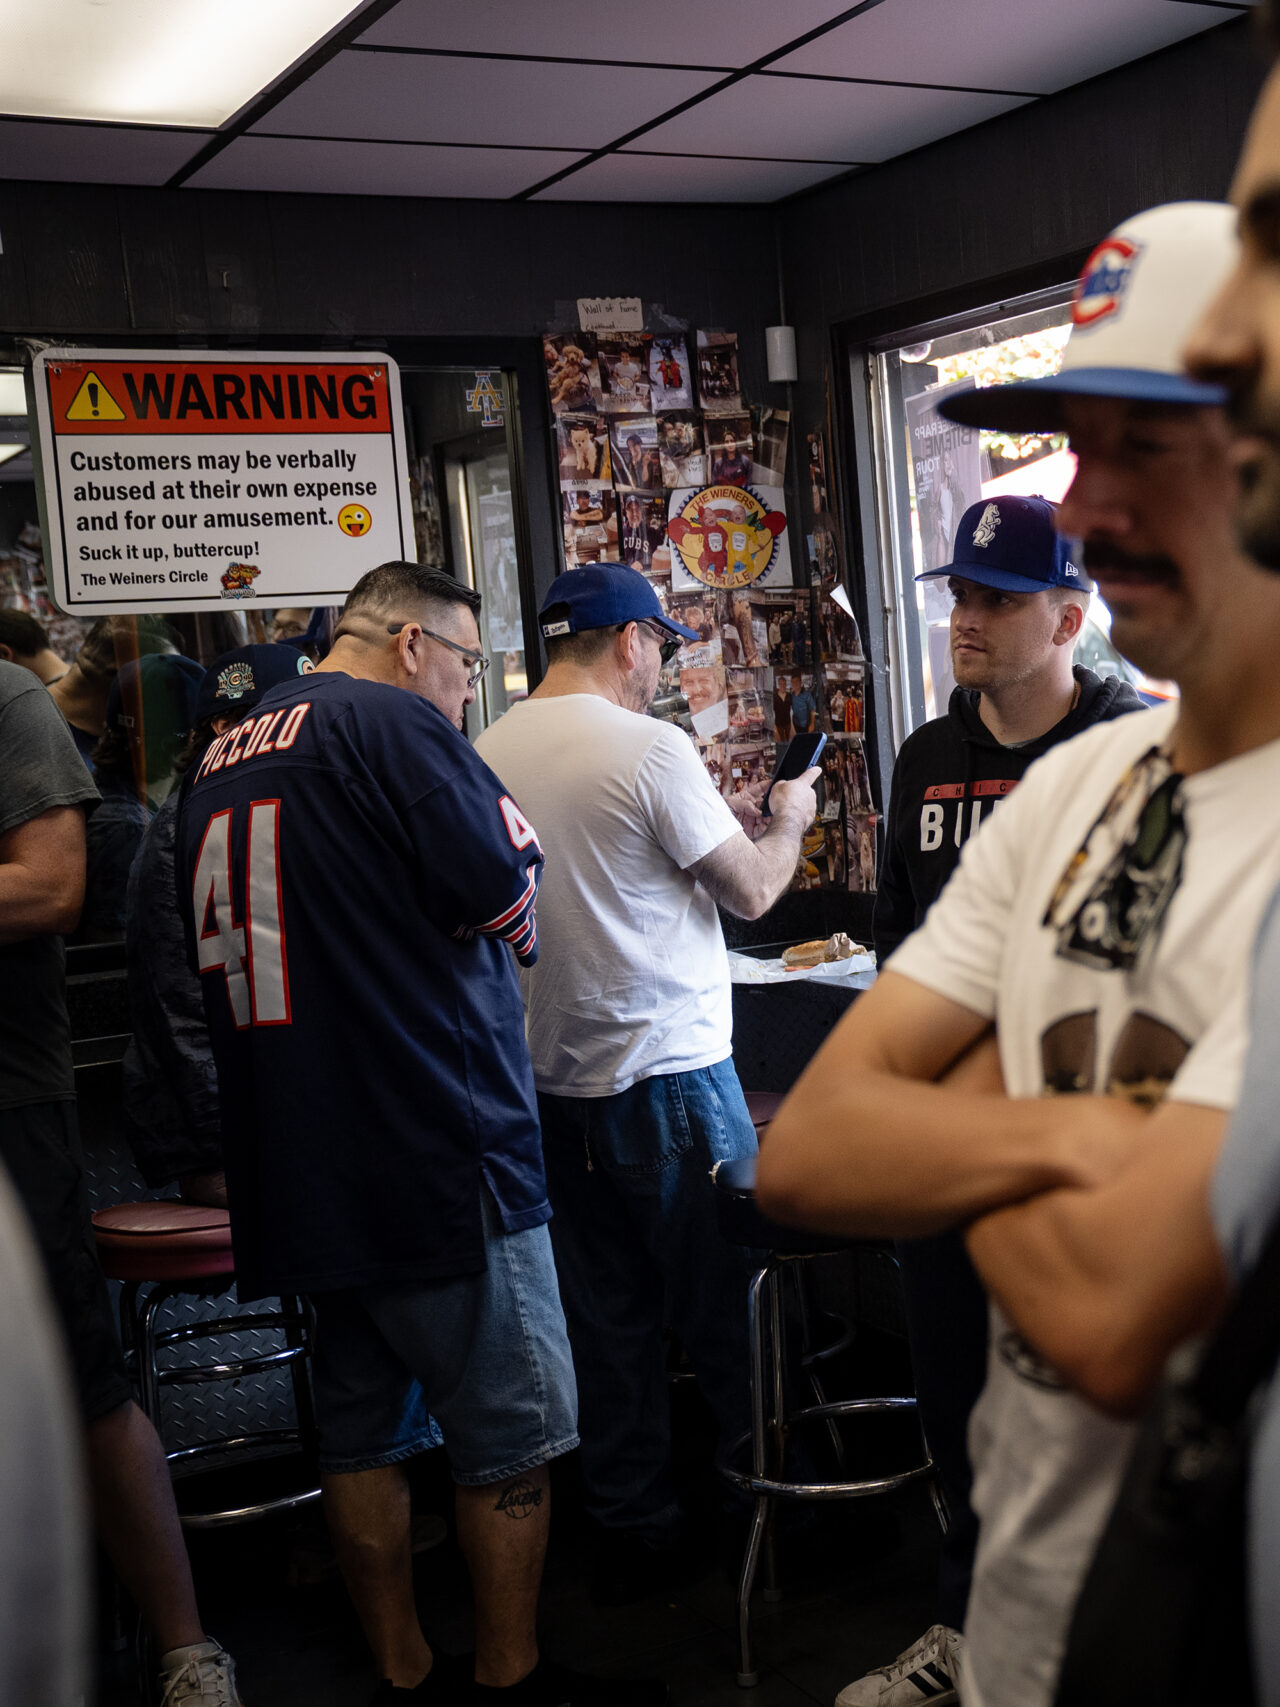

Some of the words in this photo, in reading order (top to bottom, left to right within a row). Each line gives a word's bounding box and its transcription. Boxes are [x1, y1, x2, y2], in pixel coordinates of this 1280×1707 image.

[582, 303, 602, 315] Wall
[619, 300, 639, 313] Fame
[122, 373, 377, 420] WARNING
[70, 451, 192, 471] Customers
[198, 454, 240, 473] may
[246, 450, 271, 469] be
[276, 449, 357, 472] verbally
[73, 481, 155, 501] abused
[162, 481, 185, 500] at
[189, 480, 241, 499] their
[246, 482, 288, 498] own
[294, 481, 377, 501] expense
[690, 493, 710, 512] THE
[710, 488, 755, 510] WIENERS
[76, 511, 118, 531] and
[124, 510, 156, 530] for
[161, 513, 197, 529] our
[203, 507, 334, 528] amusement.
[79, 545, 122, 561] Suck
[126, 545, 139, 560] it
[142, 547, 169, 562] up,
[173, 541, 259, 559] buttercup!
[623, 536, 650, 553] CUBS
[80, 572, 106, 586] The
[109, 571, 165, 585] Weiners
[169, 570, 208, 584] Circle
[194, 702, 311, 785] PICCOLO
[932, 782, 1006, 798] CHIC
[920, 799, 1004, 852] BU
[193, 799, 292, 1031] 41
